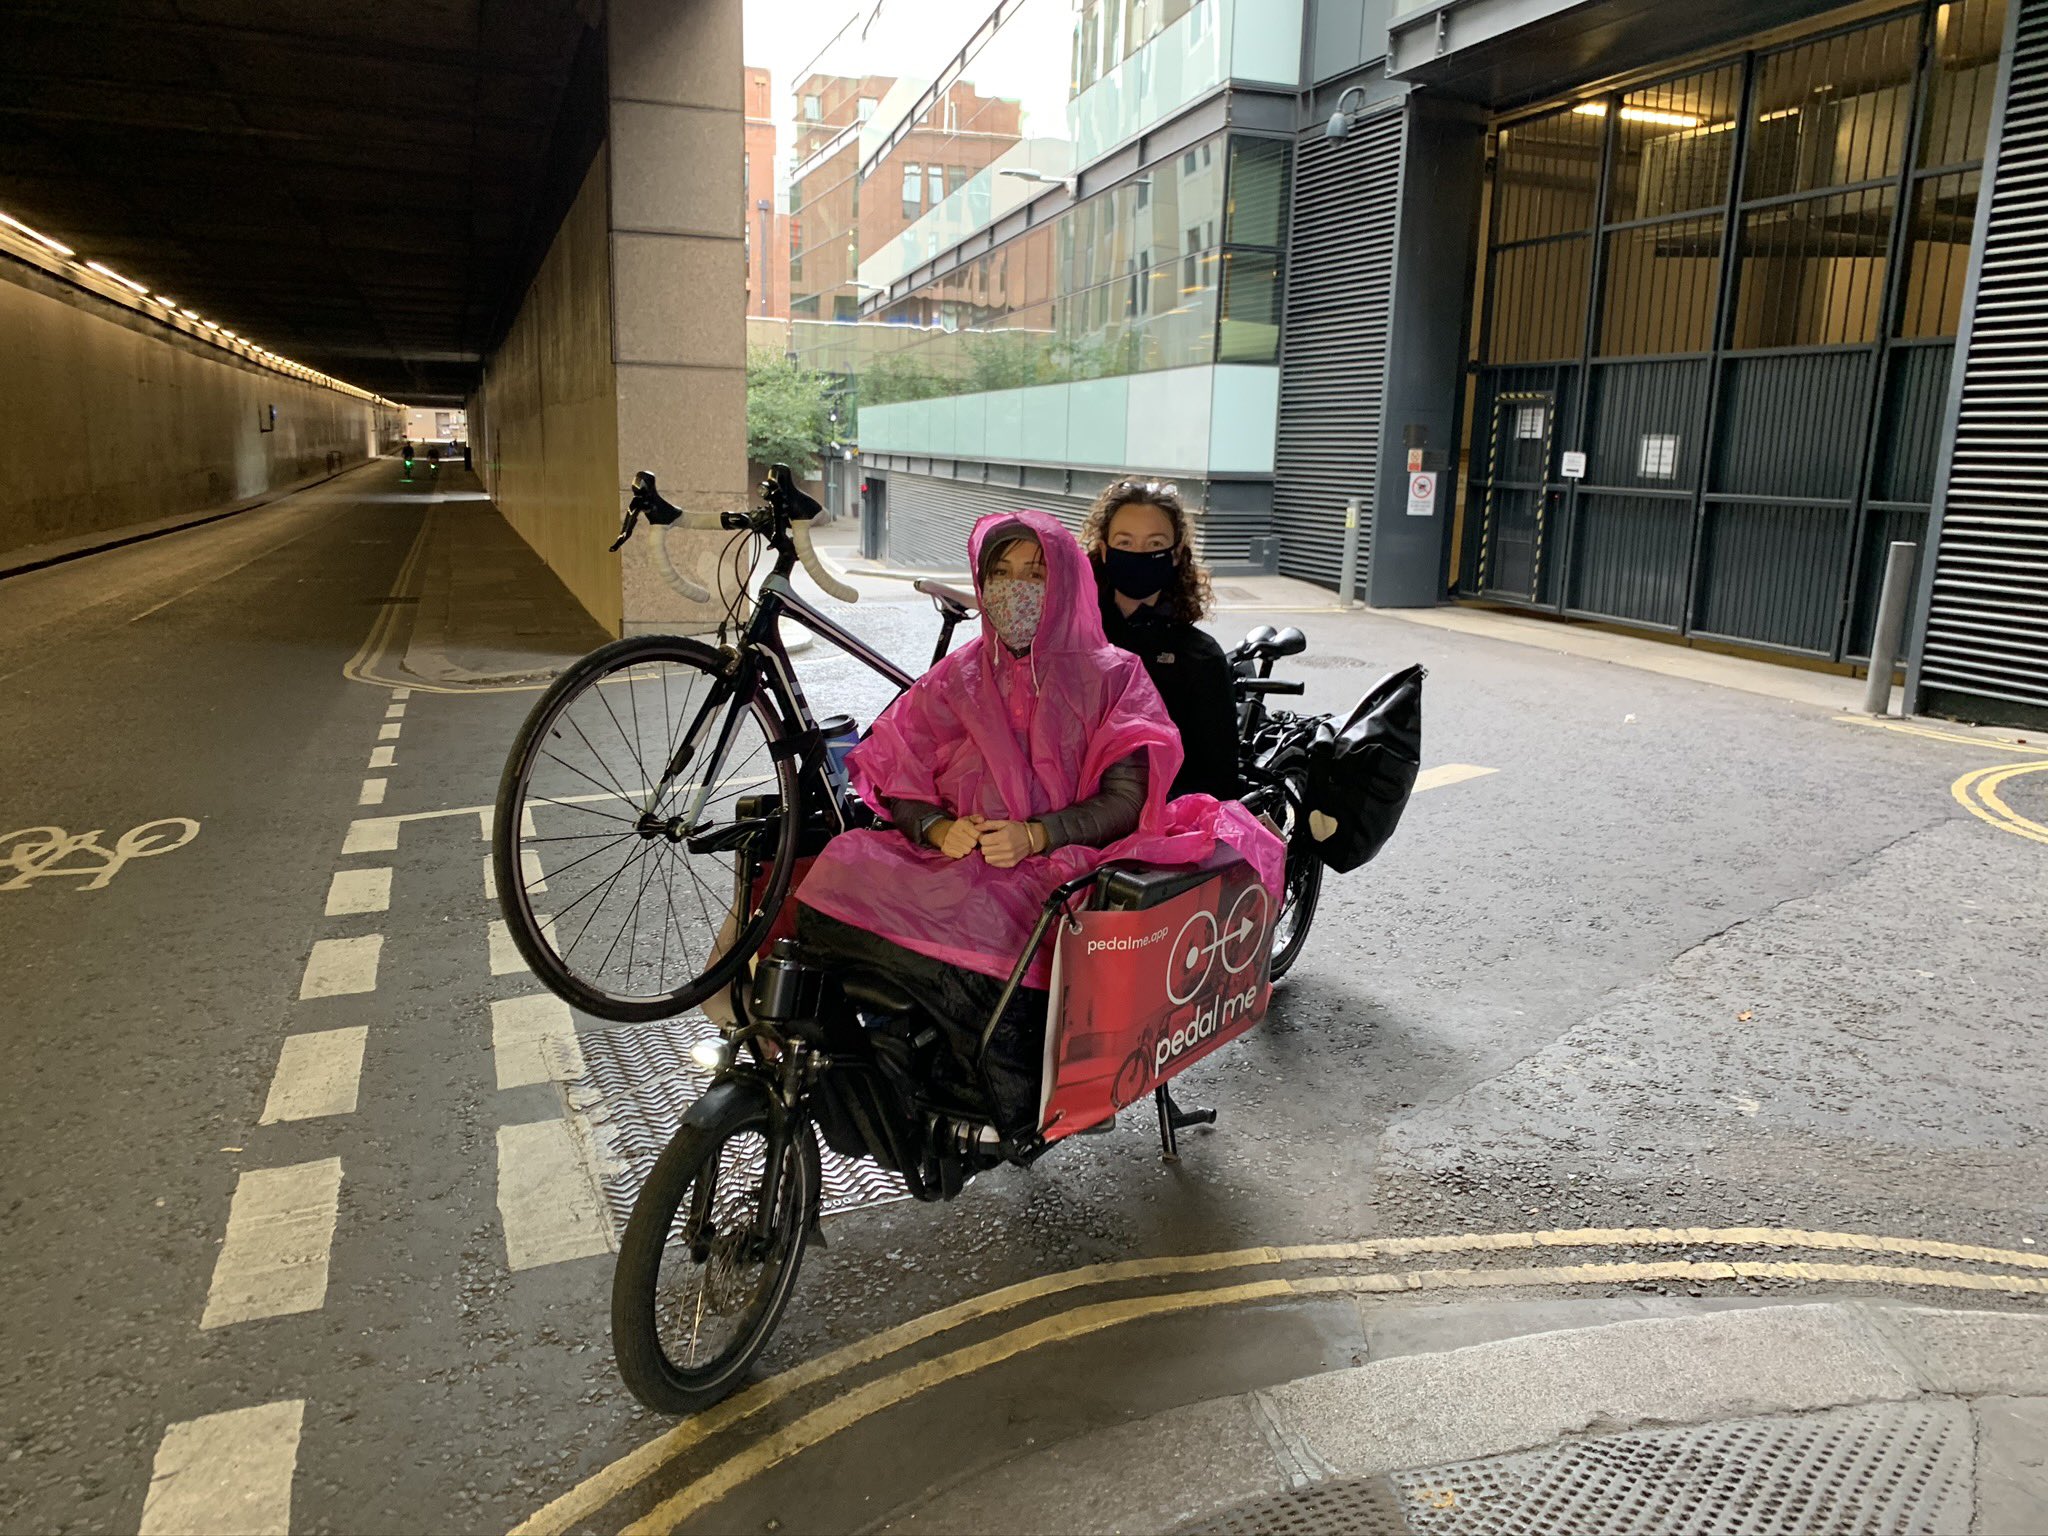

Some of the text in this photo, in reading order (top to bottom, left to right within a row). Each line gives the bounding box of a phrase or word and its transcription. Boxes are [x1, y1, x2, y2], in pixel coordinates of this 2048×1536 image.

[1088, 926, 1168, 955] pedalme.app
[1154, 985, 1256, 1079] pedal me
